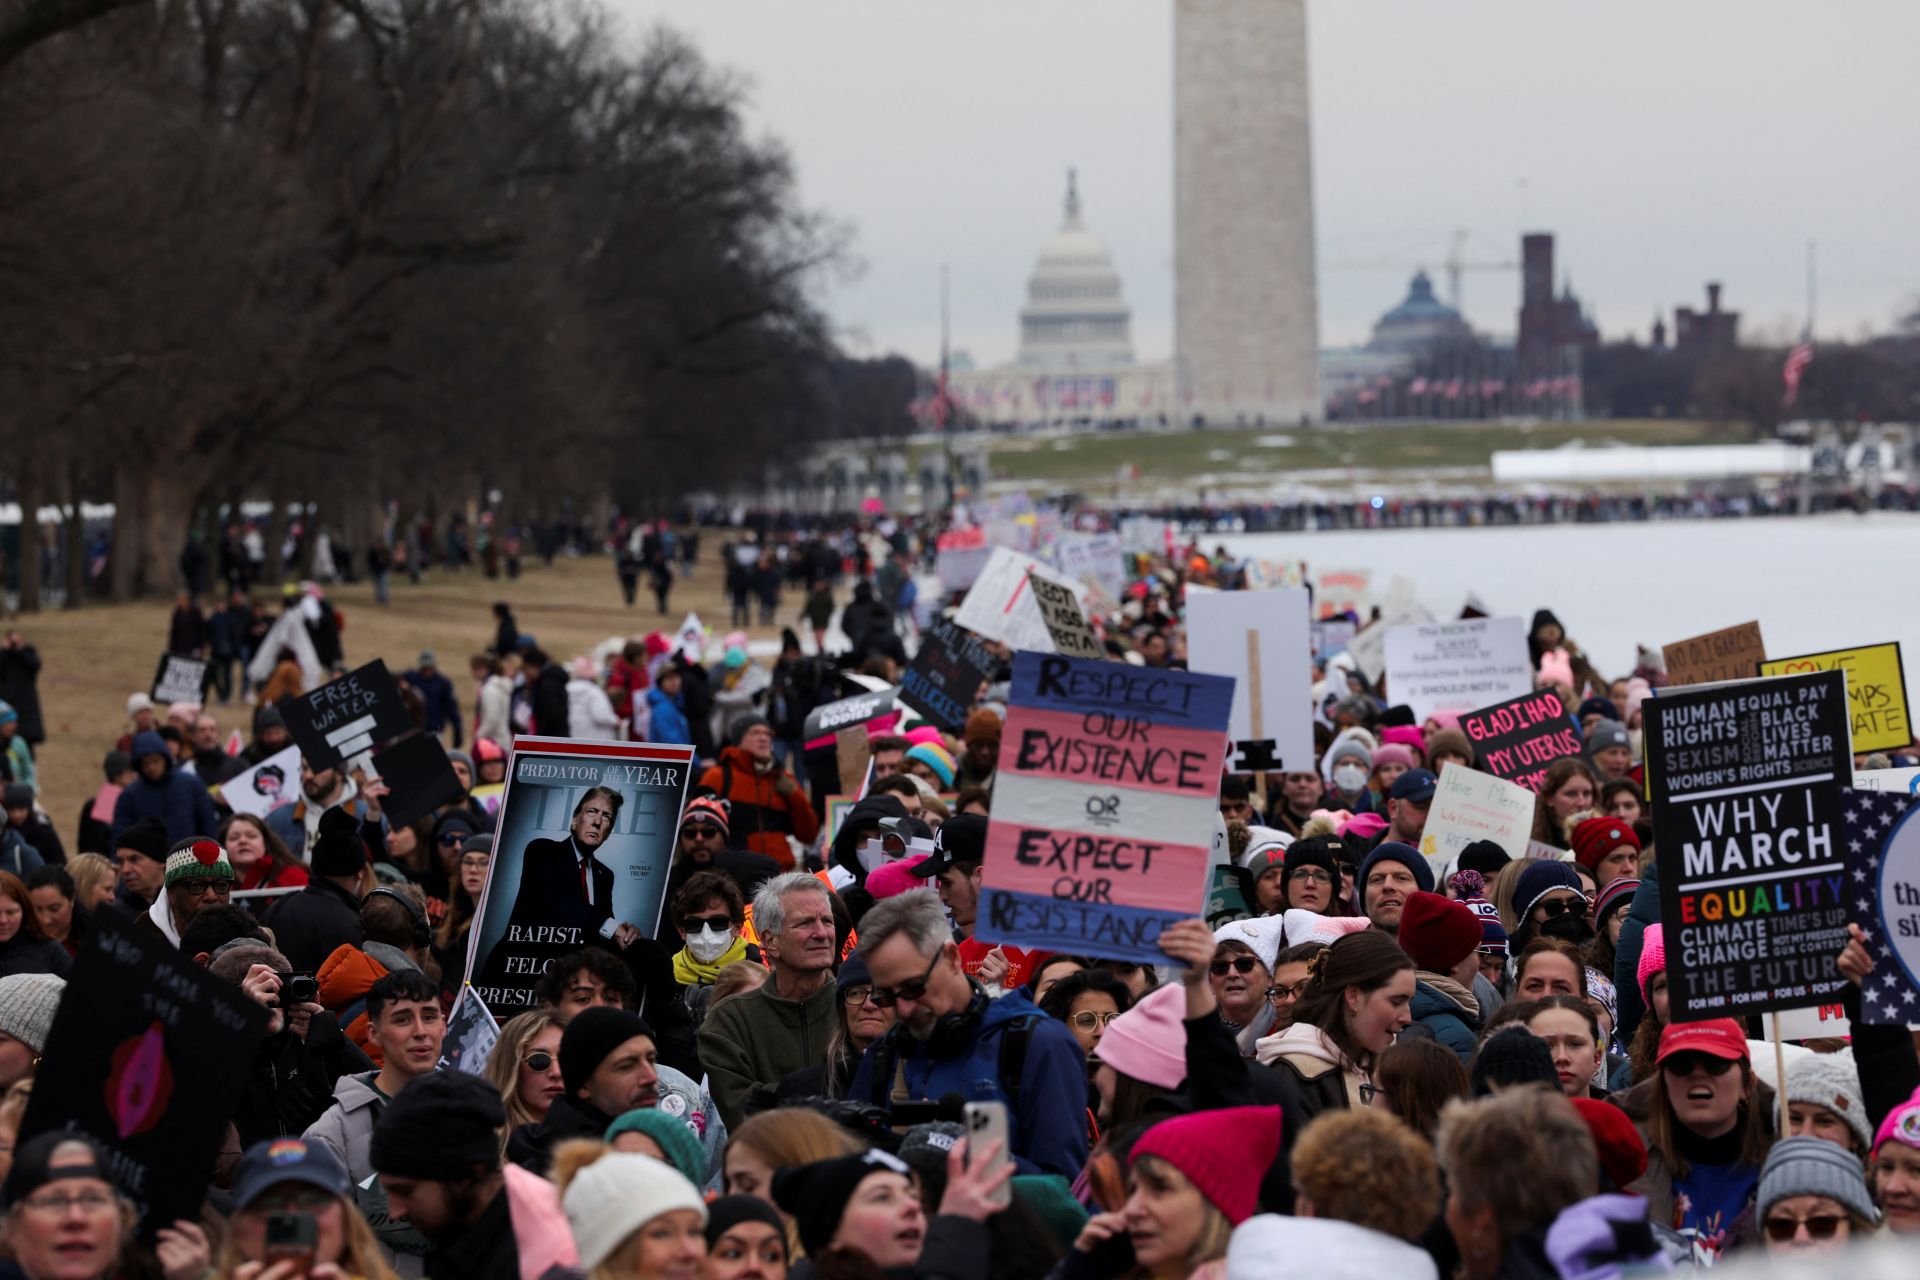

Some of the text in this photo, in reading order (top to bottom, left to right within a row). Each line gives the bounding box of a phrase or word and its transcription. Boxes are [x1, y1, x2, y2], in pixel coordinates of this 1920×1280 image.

[1667, 645, 1686, 673] NO
[309, 676, 364, 710] FREE
[1036, 657, 1202, 711] RESPECT
[311, 691, 381, 732] WATER
[1466, 694, 1564, 741] GLAD I HAD
[1661, 685, 1828, 728] HUMAN EQUAL PAY
[1761, 703, 1819, 728] BLACK
[1082, 710, 1151, 744] OUR
[1663, 720, 1738, 748] RIGHTS
[1741, 718, 1751, 765] SOCIAL
[1750, 711, 1761, 763] REFORM
[1762, 722, 1812, 744] LIVES
[1016, 728, 1208, 789] EXISTENCE
[1487, 728, 1582, 776] MY UTERUS
[1665, 744, 1740, 772] SEXISM
[1763, 735, 1833, 761] MATTER
[518, 763, 679, 787] PREDATOR OF THE YEAR
[1666, 756, 1835, 791] WOMEN'S RIGHTS SCIENCE
[1086, 795, 1120, 816] OR
[1444, 770, 1528, 814] Have Mercy
[1692, 788, 1814, 838] WHY I
[1016, 829, 1162, 874] EXPECT
[1264, 848, 1285, 865] M
[1682, 822, 1833, 877] MARCH
[1052, 876, 1114, 905] OUR
[1680, 875, 1845, 925] EQUALITY
[507, 924, 585, 945] RAPIST.
[1680, 907, 1847, 948] CLIMATE TIME'S UP
[1772, 926, 1849, 946] NOT MY PRESIDENT
[99, 931, 143, 965] WHO
[1682, 938, 1849, 968] CHANGE GUN CONTROL
[1685, 968, 1737, 996] THE
[1688, 998, 1707, 1011] FOR
[1707, 996, 1726, 1009] HER
[1731, 992, 1750, 1005] FOR
[1751, 989, 1769, 1002] HIM
[1774, 987, 1793, 999] FOR
[1793, 985, 1807, 997] US
[1811, 982, 1831, 995] FOR
